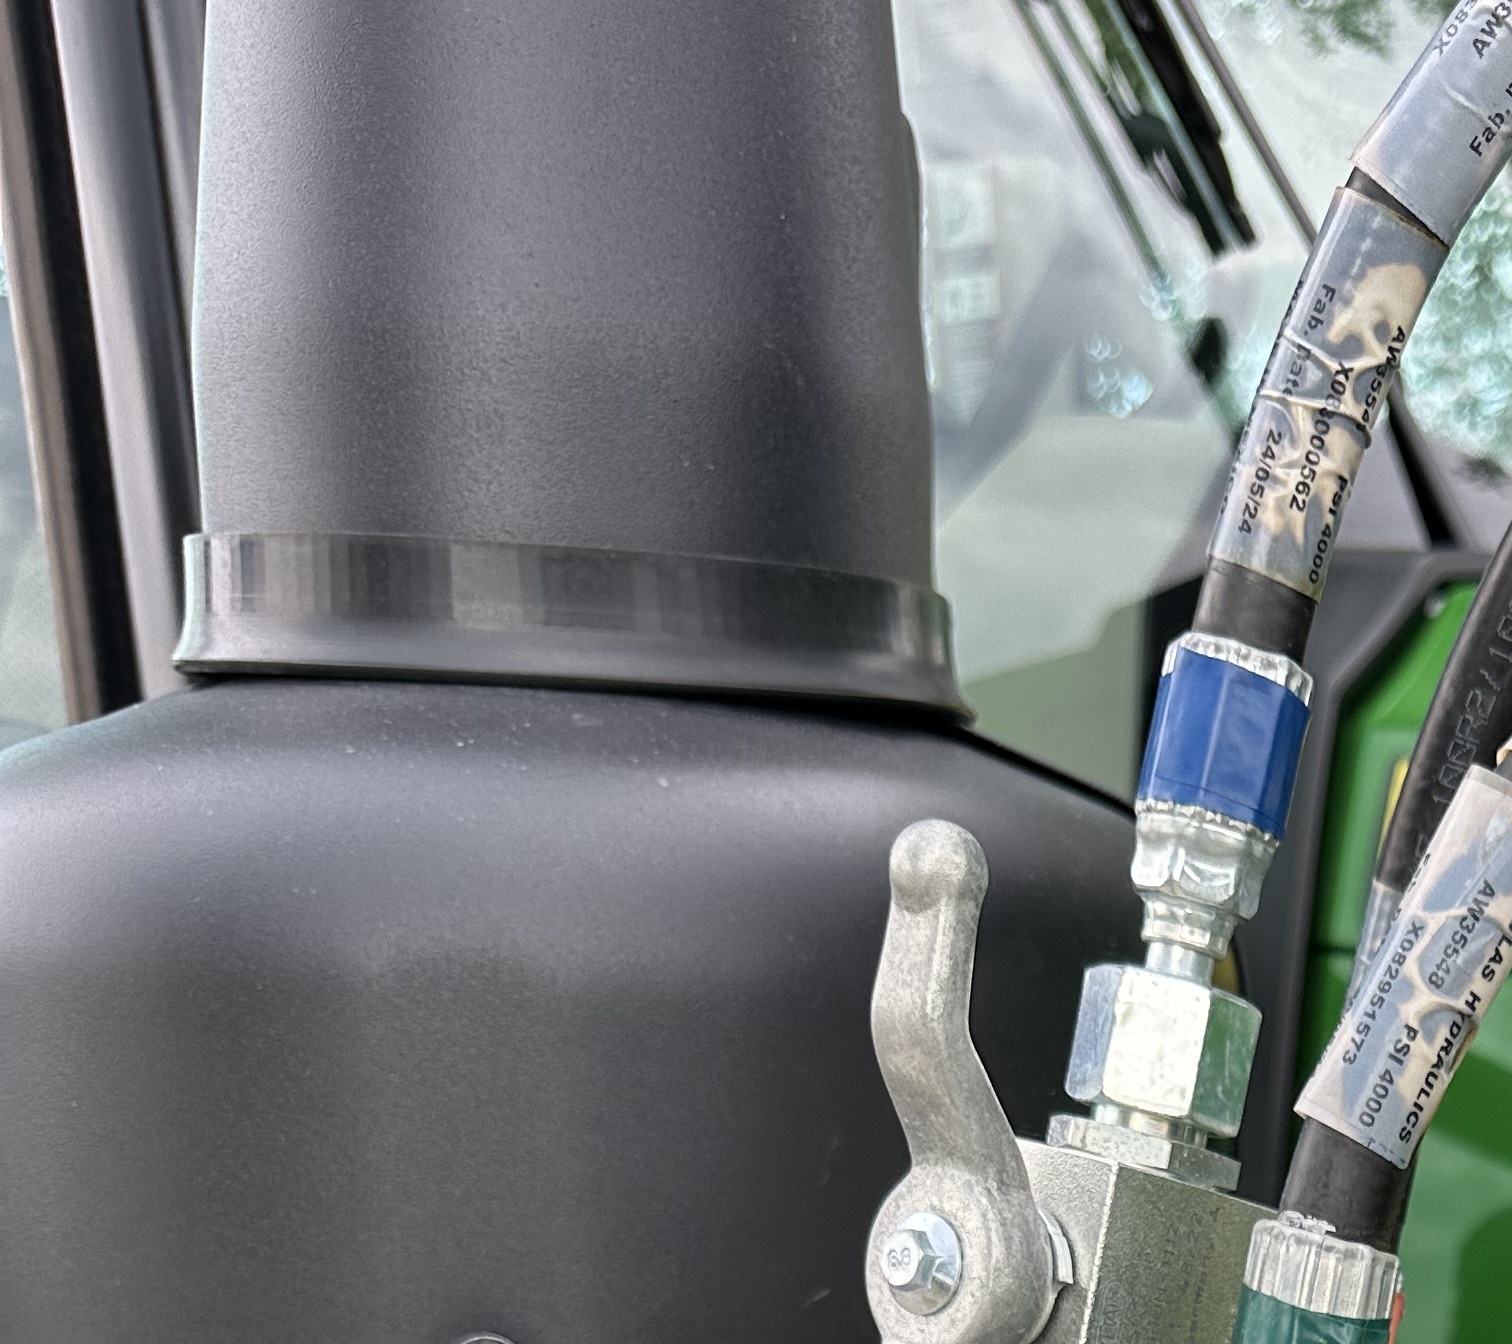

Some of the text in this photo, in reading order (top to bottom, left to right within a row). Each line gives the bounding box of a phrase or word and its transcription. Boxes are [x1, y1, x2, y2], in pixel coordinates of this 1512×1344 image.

[1469, 108, 1511, 157] Fab.
[1304, 283, 1336, 336] Fab.
[1238, 428, 1282, 535] 24/05/24
[1308, 522, 1333, 585] 4000
[1427, 878, 1497, 990] AW35548
[1342, 920, 1425, 1066] X082951573
[1358, 1023, 1420, 1128] PSI 4000
[1399, 989, 1482, 1146] HYDRAULICS
